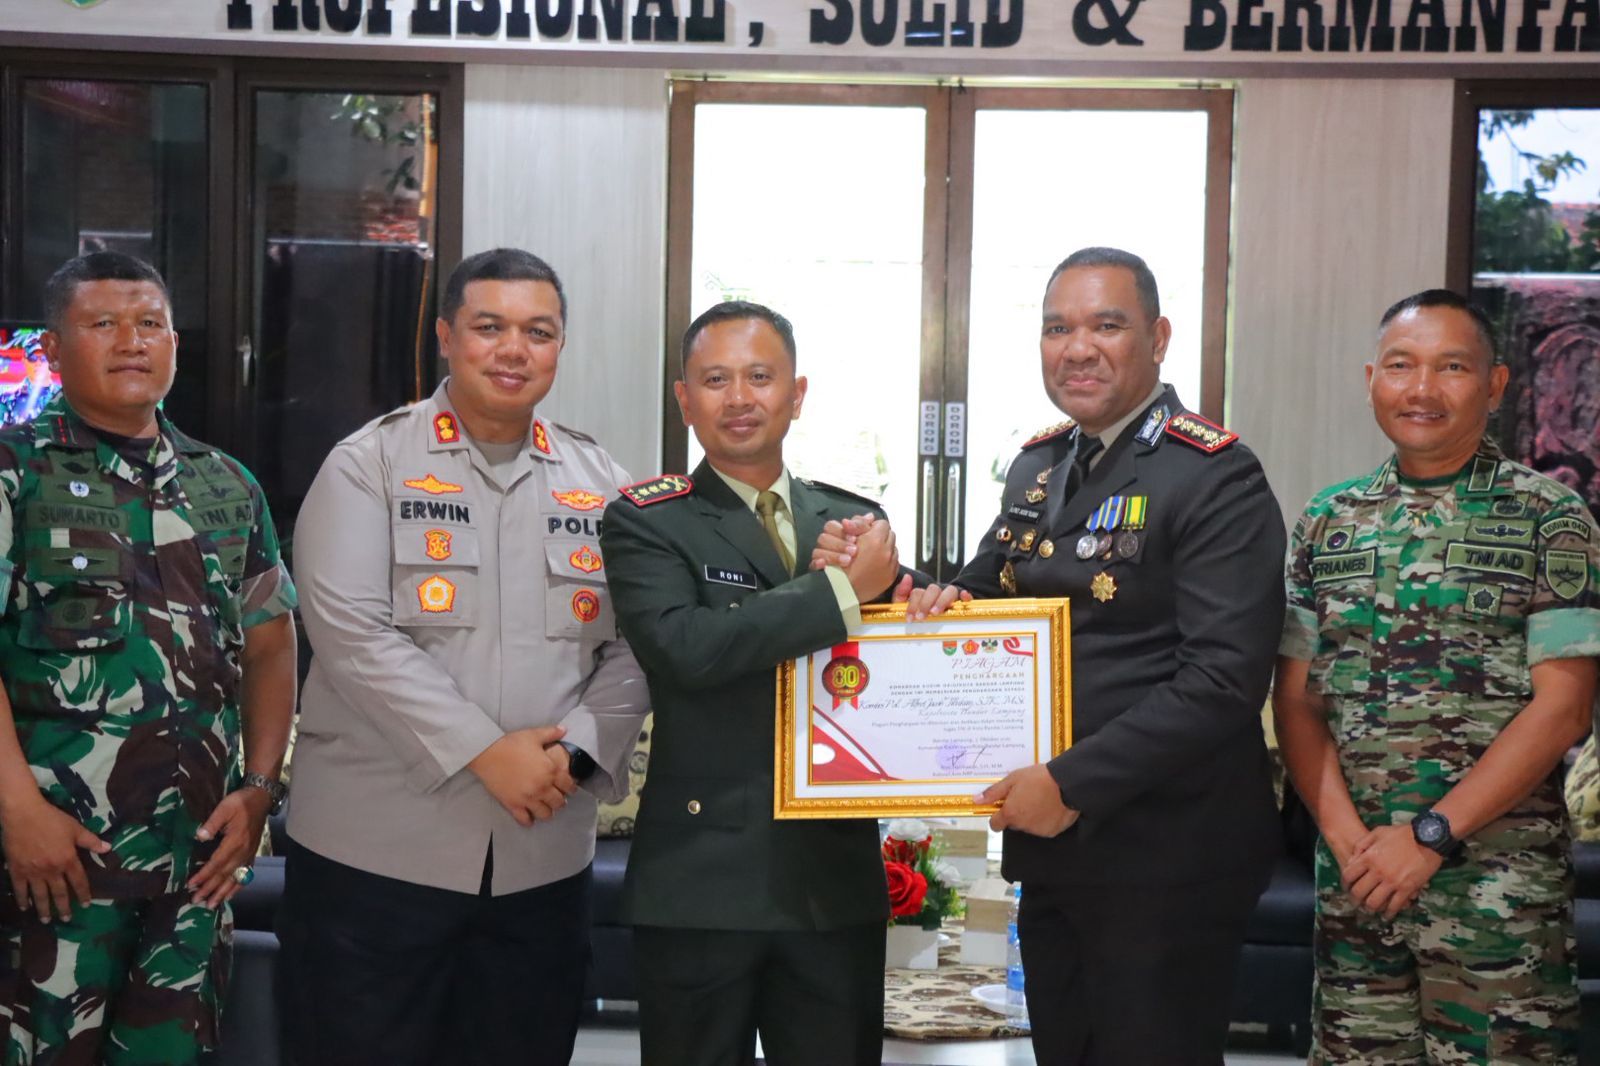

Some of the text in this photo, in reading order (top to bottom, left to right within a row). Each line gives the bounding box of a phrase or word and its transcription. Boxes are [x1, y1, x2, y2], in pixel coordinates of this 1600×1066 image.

[1071, 0, 1145, 46] &
[40, 504, 121, 528] SUMARTO
[200, 509, 229, 526] TNI
[400, 501, 470, 523] ERWIN
[1465, 550, 1498, 567] TNI
[719, 571, 743, 582] RONI
